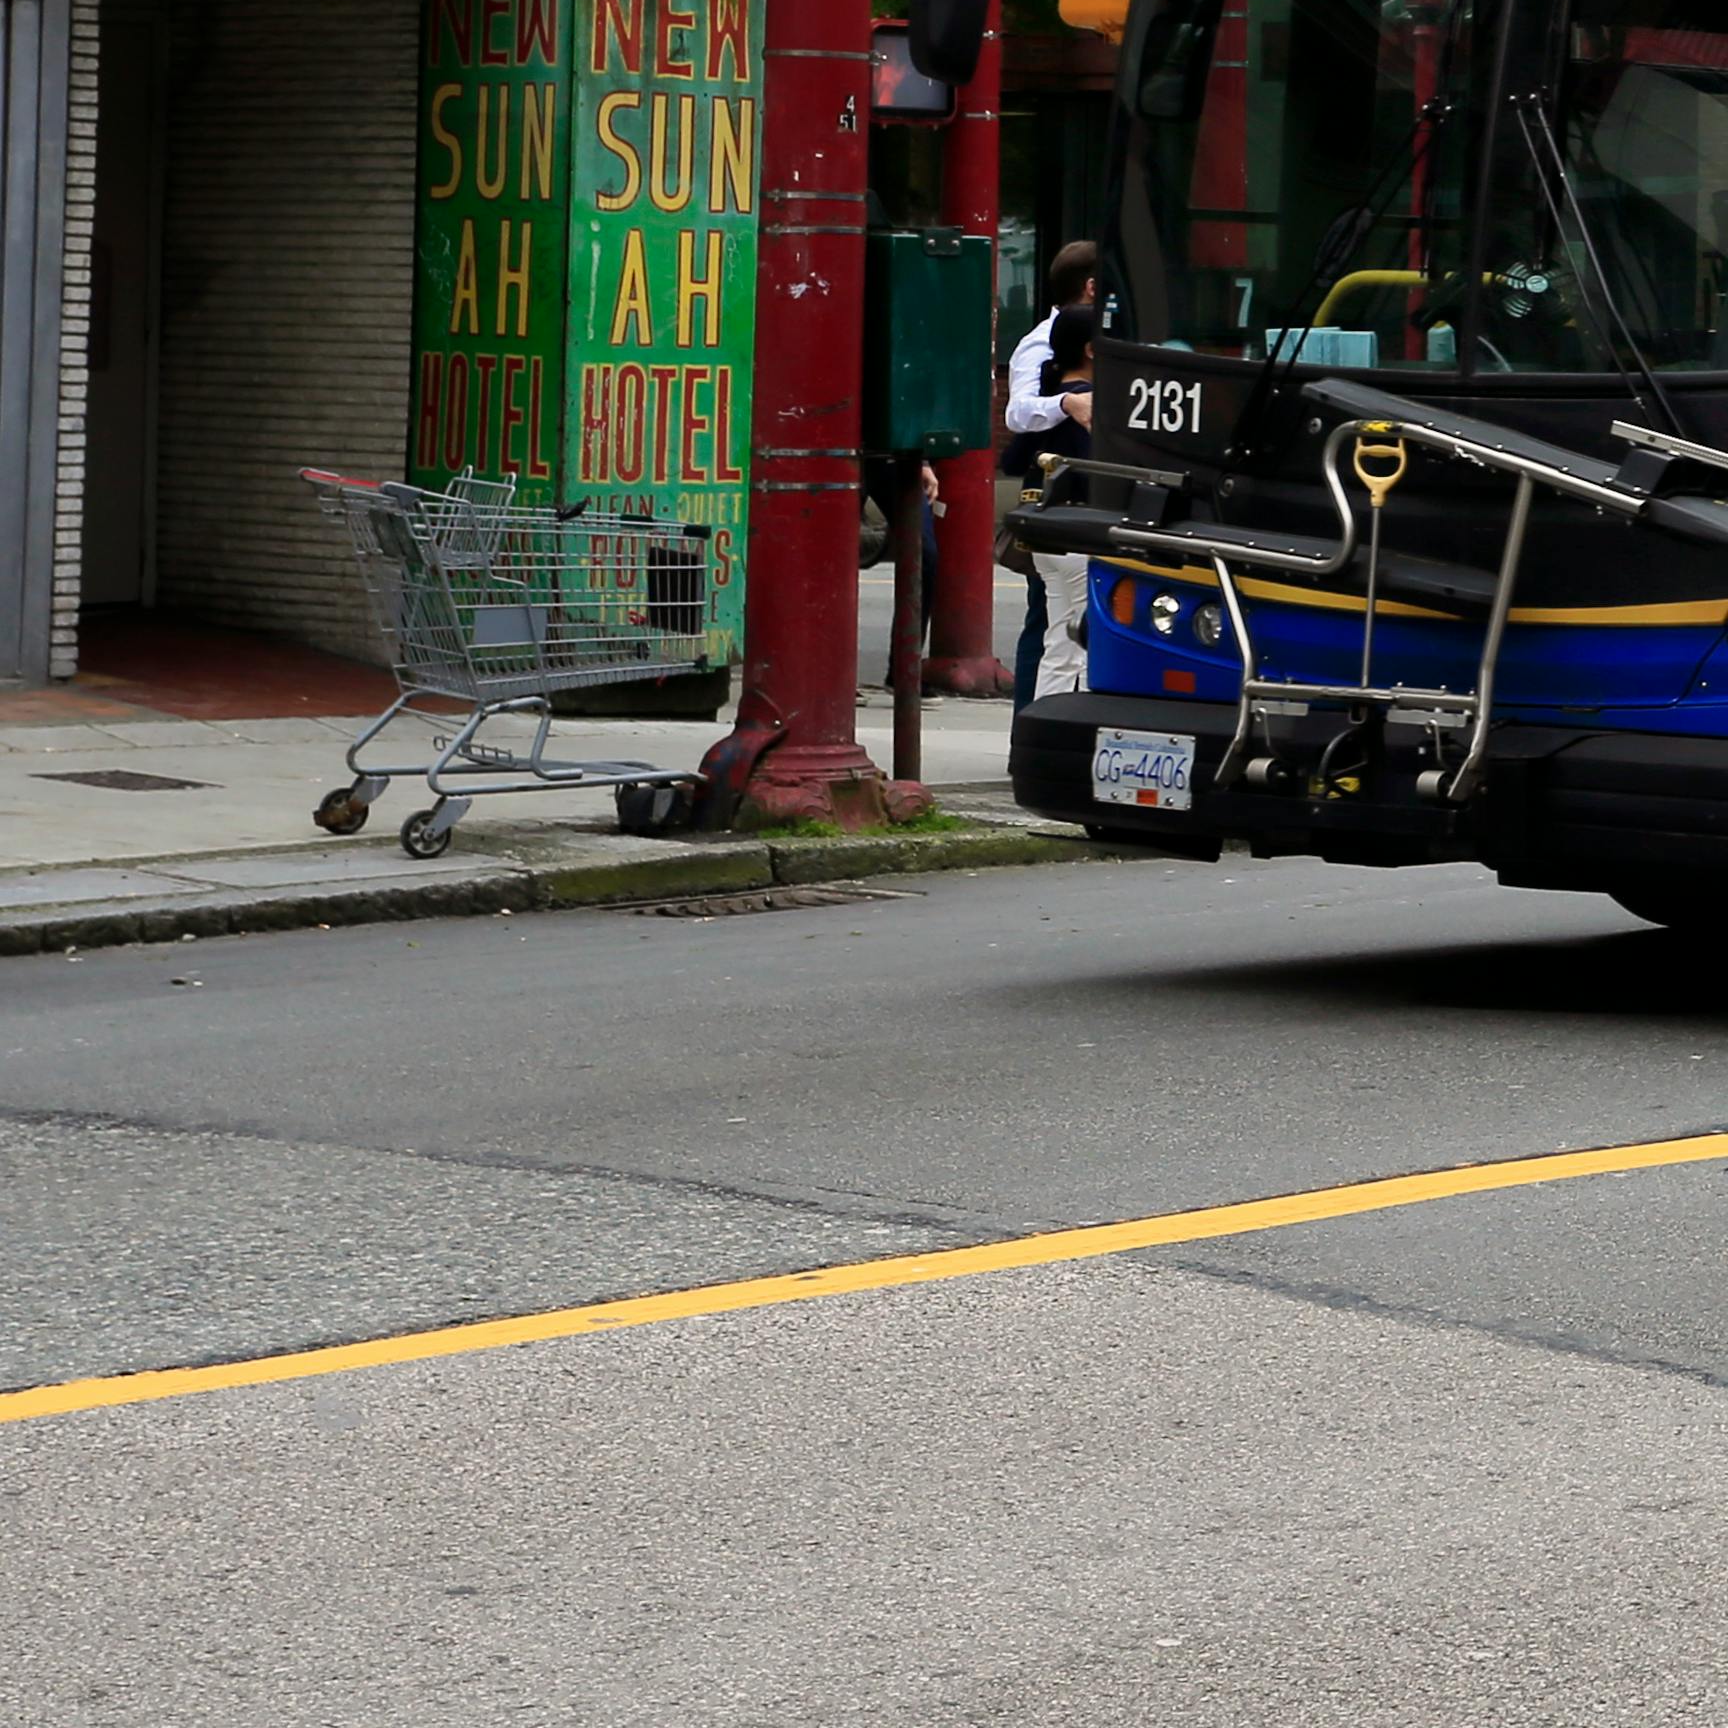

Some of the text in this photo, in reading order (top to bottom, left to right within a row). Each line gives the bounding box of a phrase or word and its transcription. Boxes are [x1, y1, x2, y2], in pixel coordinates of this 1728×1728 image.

[429, 83, 556, 201] SUN
[597, 90, 755, 214] SUN
[449, 218, 533, 338] AH
[610, 228, 725, 348] AH
[416, 351, 550, 480] HOTEL
[578, 361, 743, 485] HOTEL
[1127, 377, 1202, 434] 2131
[589, 528, 733, 590] ROS
[676, 492, 742, 525] QUIET
